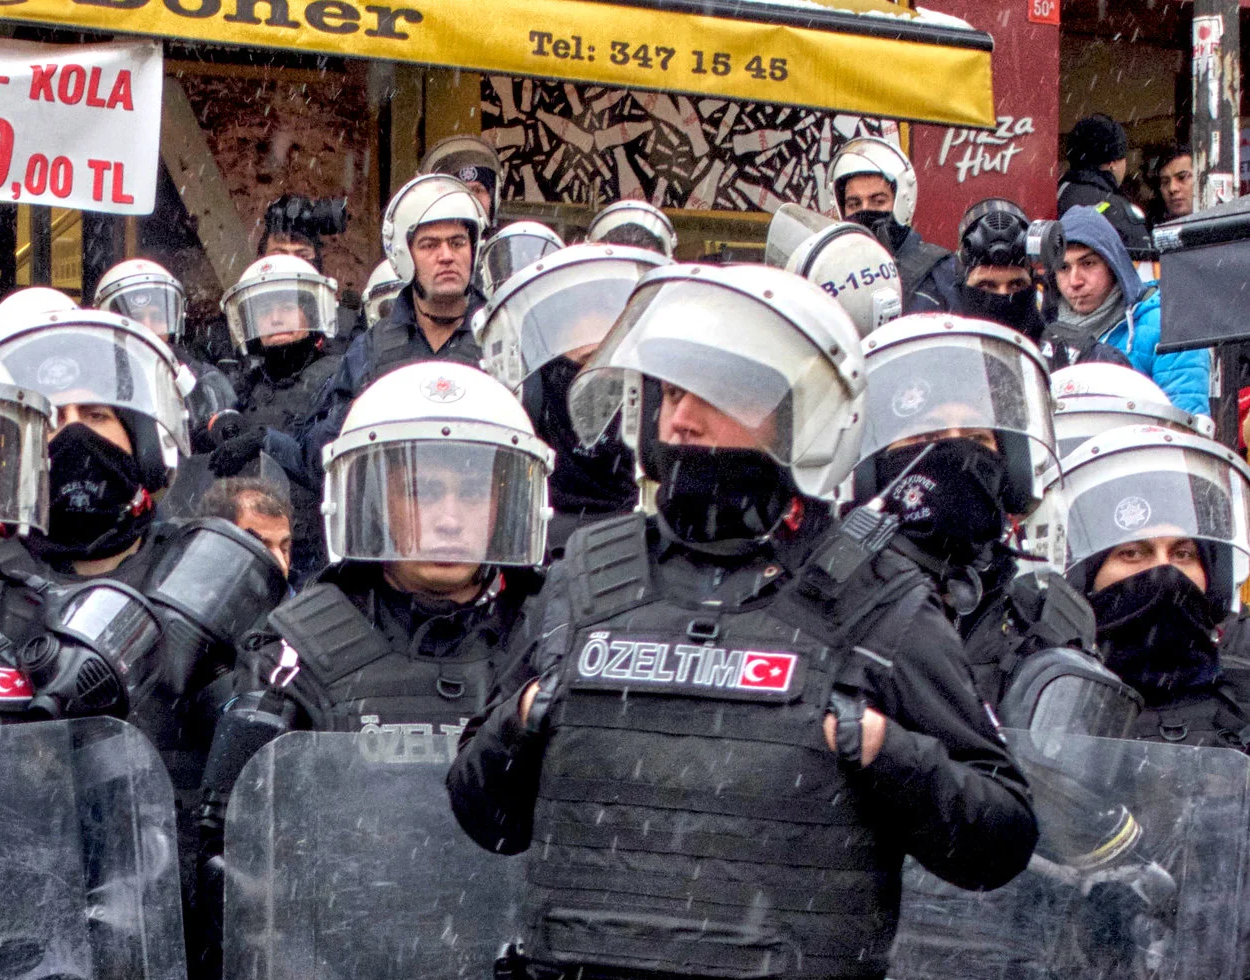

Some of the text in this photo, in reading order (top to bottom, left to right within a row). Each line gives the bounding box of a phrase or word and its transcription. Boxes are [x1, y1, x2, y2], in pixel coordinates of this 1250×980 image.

[528, 30, 789, 82] Tel: 347 15 45
[28, 63, 135, 112] KOLA
[87, 158, 135, 206] TL
[956, 142, 1023, 183] Hut
